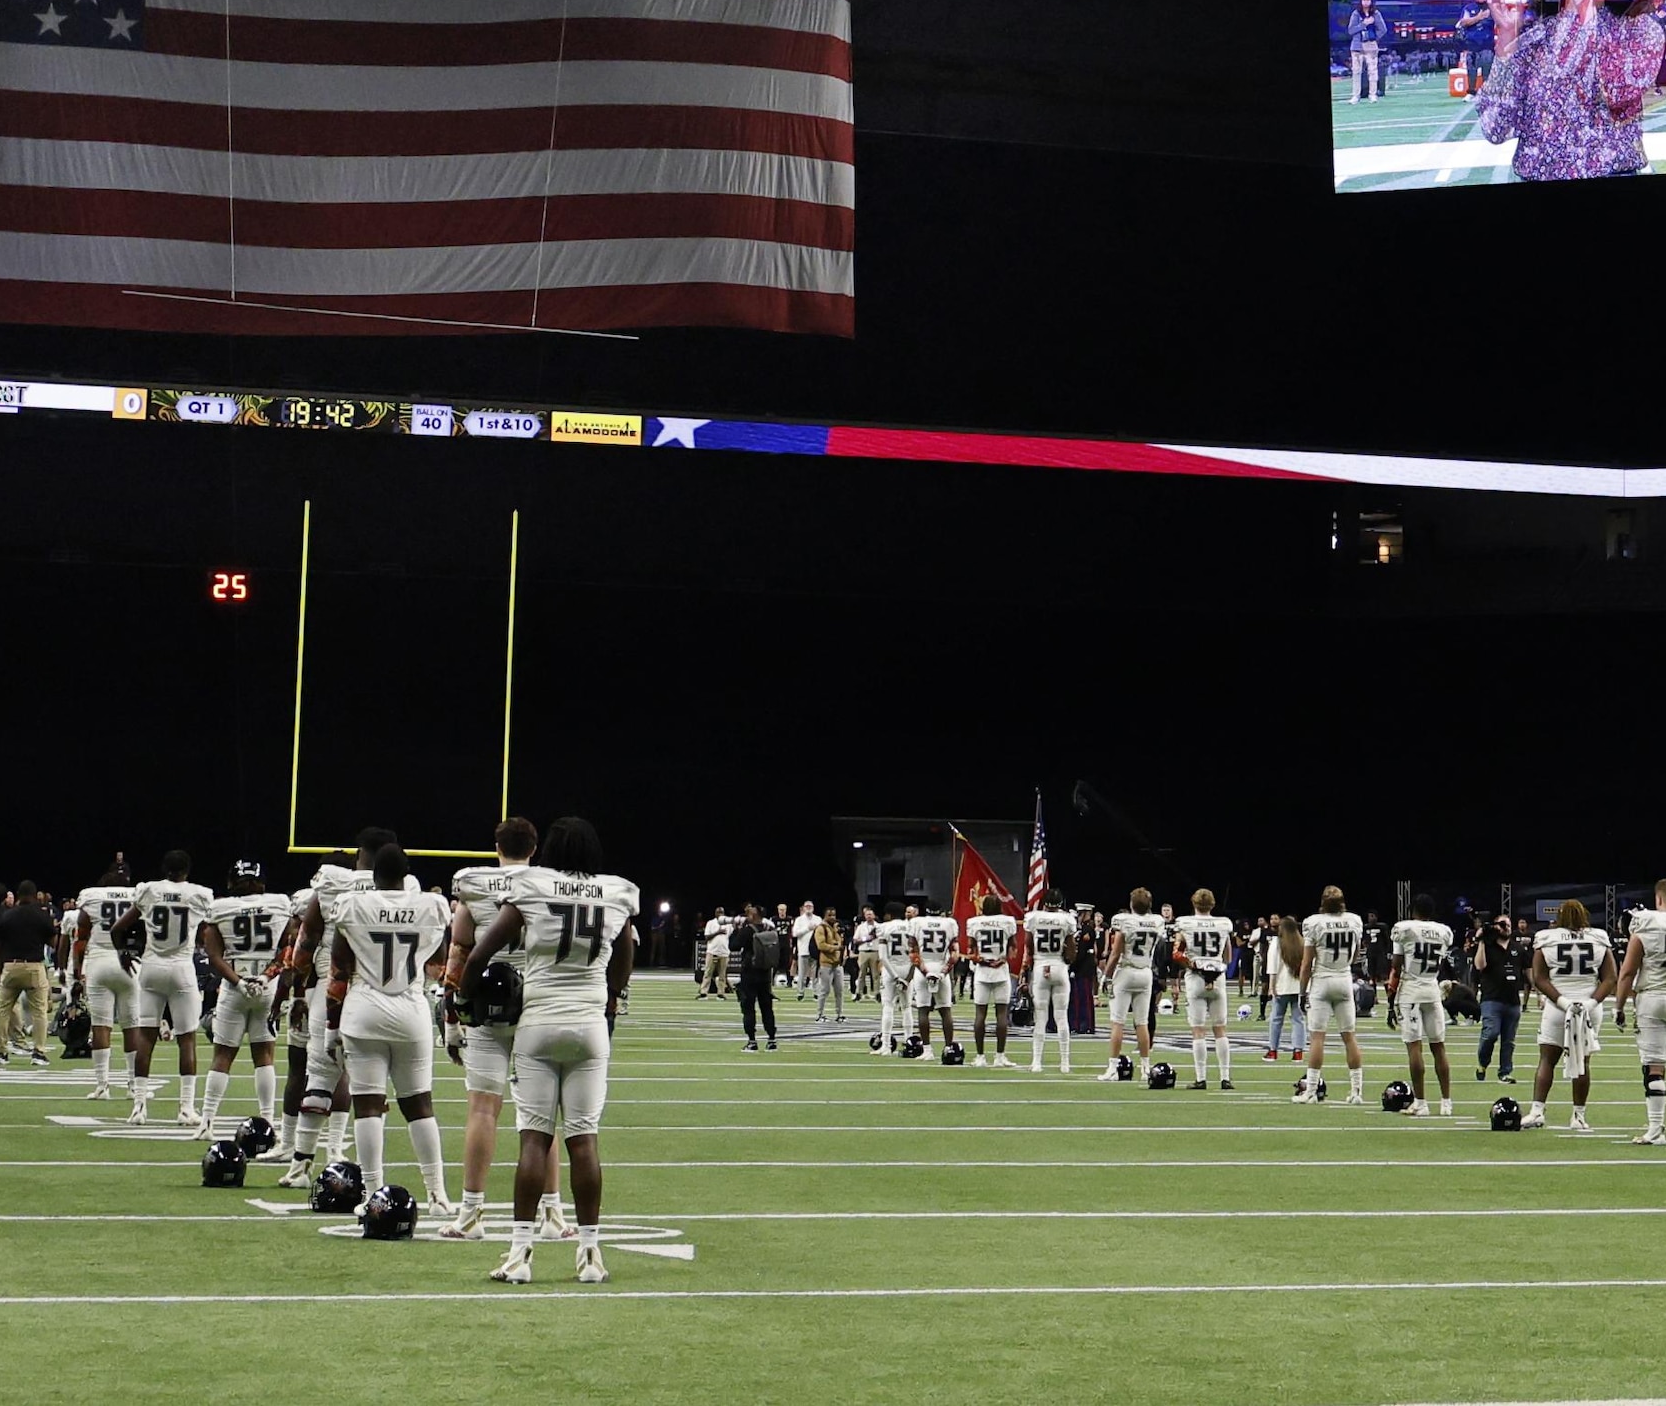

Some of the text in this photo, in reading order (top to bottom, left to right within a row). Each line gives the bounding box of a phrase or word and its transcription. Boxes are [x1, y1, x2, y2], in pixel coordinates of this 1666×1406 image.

[123, 392, 141, 413] 0
[188, 402, 224, 415] QT 1
[287, 401, 354, 427] 19:42
[416, 408, 448, 417] BALL ON
[421, 418, 441, 430] 40
[478, 417, 532, 431] 1st&10
[555, 427, 637, 438] ALAMODOME
[213, 574, 246, 599] 25
[553, 881, 603, 899] THOMPSON
[152, 906, 189, 944] 97
[379, 910, 414, 924] PLAZZ
[233, 915, 273, 951] 95
[546, 902, 605, 967] 74
[922, 930, 947, 954] 23
[980, 929, 1004, 954] 24
[1037, 929, 1061, 953] 26
[1134, 932, 1159, 956] 27
[1193, 932, 1220, 957] 43
[1326, 932, 1355, 961] 44
[1414, 943, 1443, 974] 45
[369, 931, 420, 987] 77
[1556, 943, 1595, 975] 52
